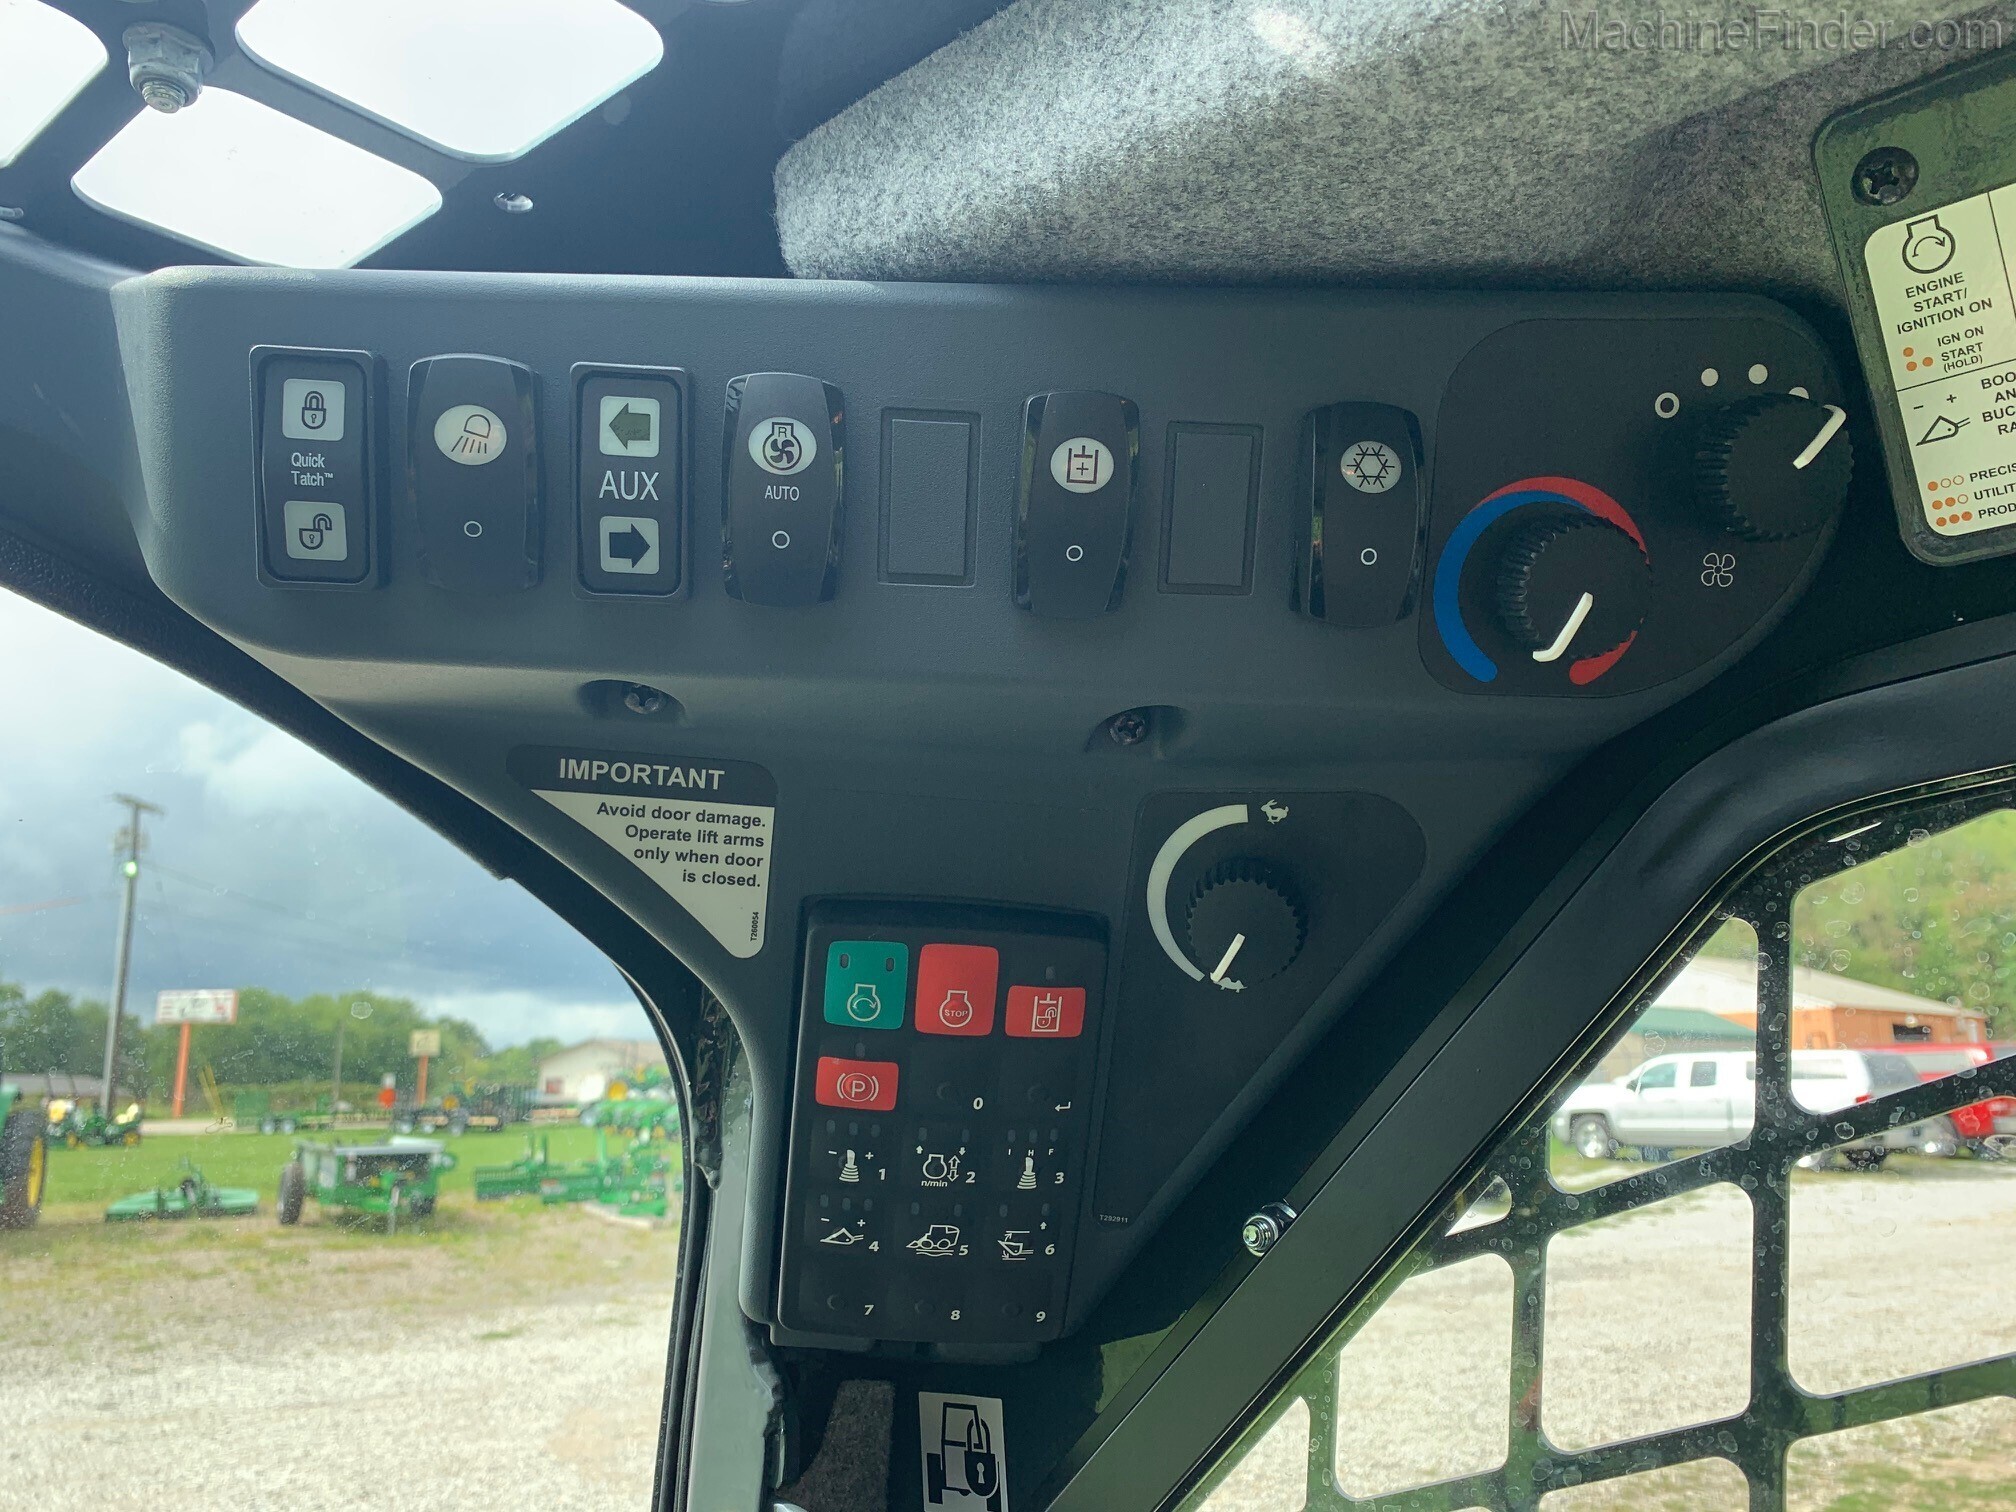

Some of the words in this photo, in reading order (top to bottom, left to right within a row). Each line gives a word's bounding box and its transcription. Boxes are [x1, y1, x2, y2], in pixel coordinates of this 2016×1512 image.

[1905, 272, 1965, 299] ENGINE
[1913, 287, 1968, 313] START/
[1896, 306, 1965, 335] IGNITION
[1969, 298, 1993, 313] ON
[1937, 332, 1961, 347] IGN
[1964, 326, 1985, 339] ON
[1941, 342, 1983, 361] START
[1943, 354, 1983, 373] (HOLD)
[777, 426, 788, 438] R
[291, 452, 325, 468] Quick
[598, 470, 660, 501] AUX
[764, 485, 800, 501] AUTO
[559, 757, 726, 791] IMPORTANT
[596, 801, 646, 818] Avoid
[651, 805, 691, 821] door
[695, 809, 766, 829] damage.
[625, 824, 692, 842] Operate
[697, 829, 719, 844] lift
[723, 834, 764, 847] arms
[634, 847, 671, 864] only
[675, 849, 719, 864] when
[724, 852, 764, 867] door
[682, 869, 696, 883] is
[701, 871, 761, 887] closed.
[750, 911, 760, 942] T260054
[944, 1008, 968, 1018] STOP
[851, 1080, 866, 1098] P
[972, 1097, 984, 1110] 0
[1048, 1148, 1055, 1156] F
[878, 1168, 886, 1181] 1
[965, 1171, 976, 1184] 2
[1054, 1171, 1065, 1184] 3
[921, 1180, 948, 1188] n/min
[868, 1240, 880, 1252] 4
[958, 1244, 969, 1256] 5
[1044, 1244, 1055, 1256] 6
[864, 1304, 875, 1316] 7
[950, 1309, 961, 1321] 8
[1035, 1311, 1046, 1323] 9
